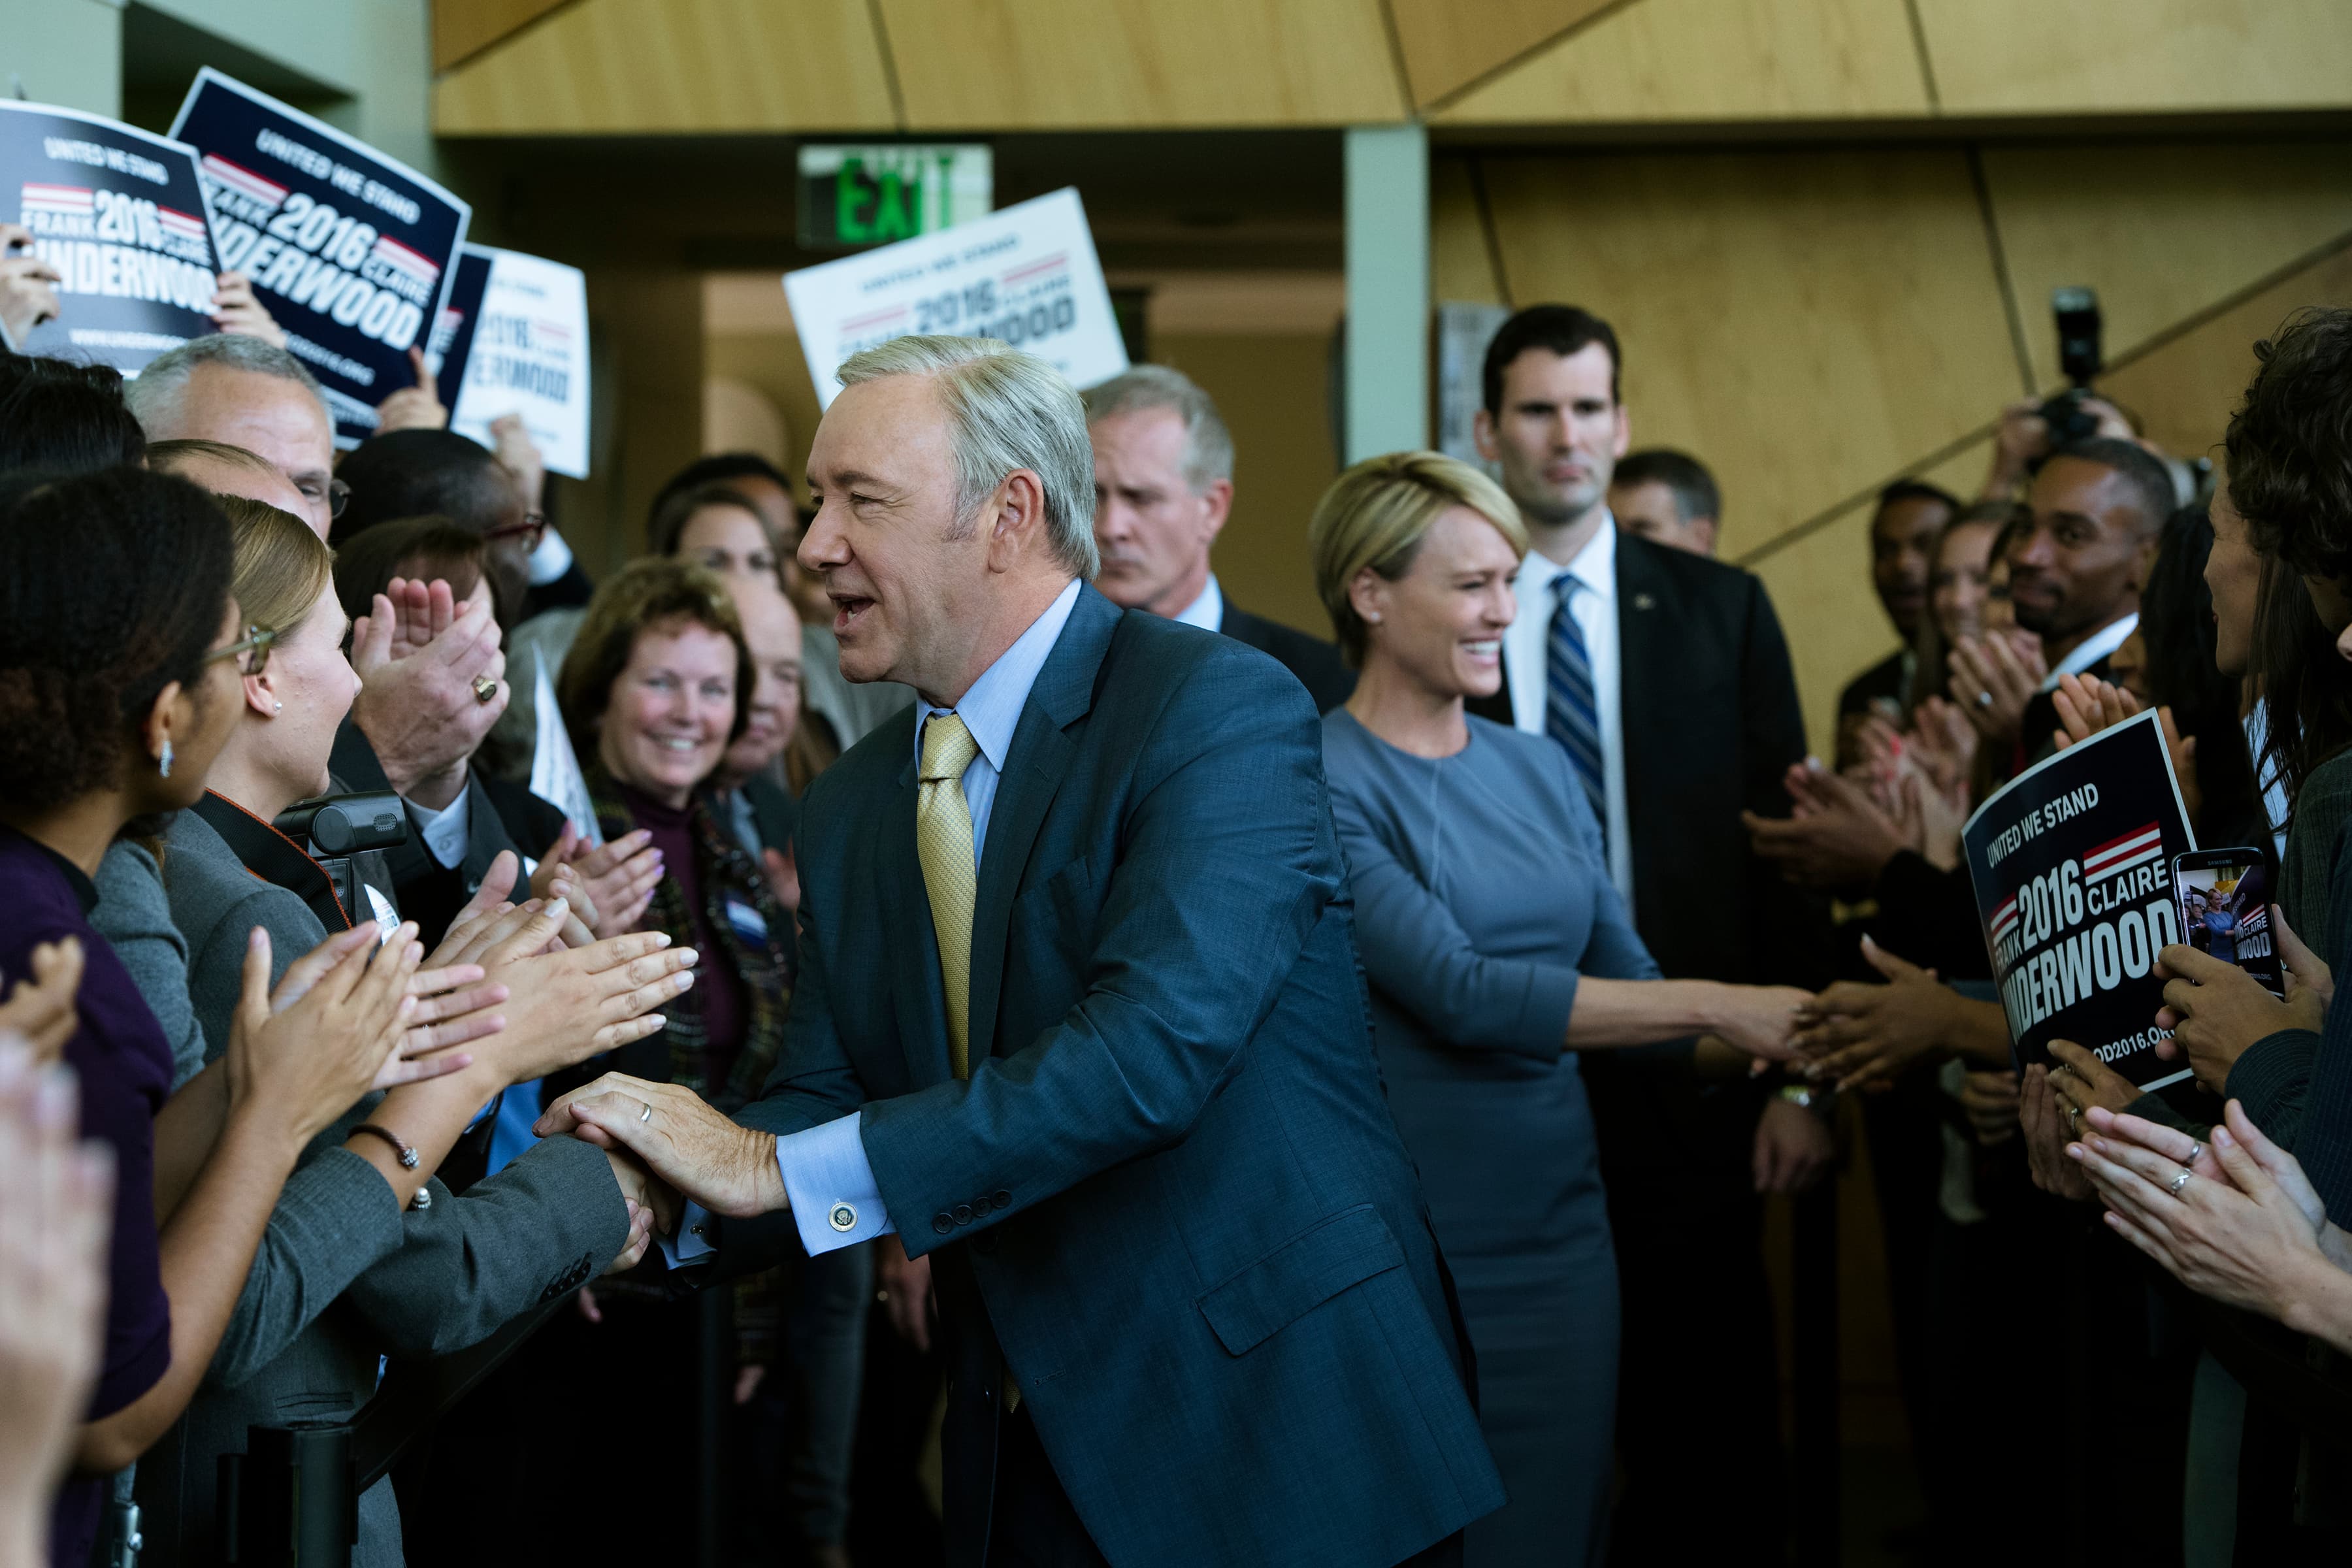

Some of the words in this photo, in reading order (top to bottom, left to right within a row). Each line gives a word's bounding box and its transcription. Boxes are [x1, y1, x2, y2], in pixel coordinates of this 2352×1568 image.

[255, 128, 333, 180] UNITED
[331, 163, 366, 197] WE
[361, 179, 421, 225] STAND
[836, 154, 956, 243] EXIT
[95, 189, 162, 252] 2016
[266, 192, 378, 272] 2016
[1987, 823, 2021, 869] UNITED
[2021, 809, 2044, 841] WE
[2046, 783, 2099, 829] STAND
[2018, 858, 2083, 951] 2016
[2087, 858, 2170, 915] CLAIRE
[2244, 916, 2268, 936] CLAIRE
